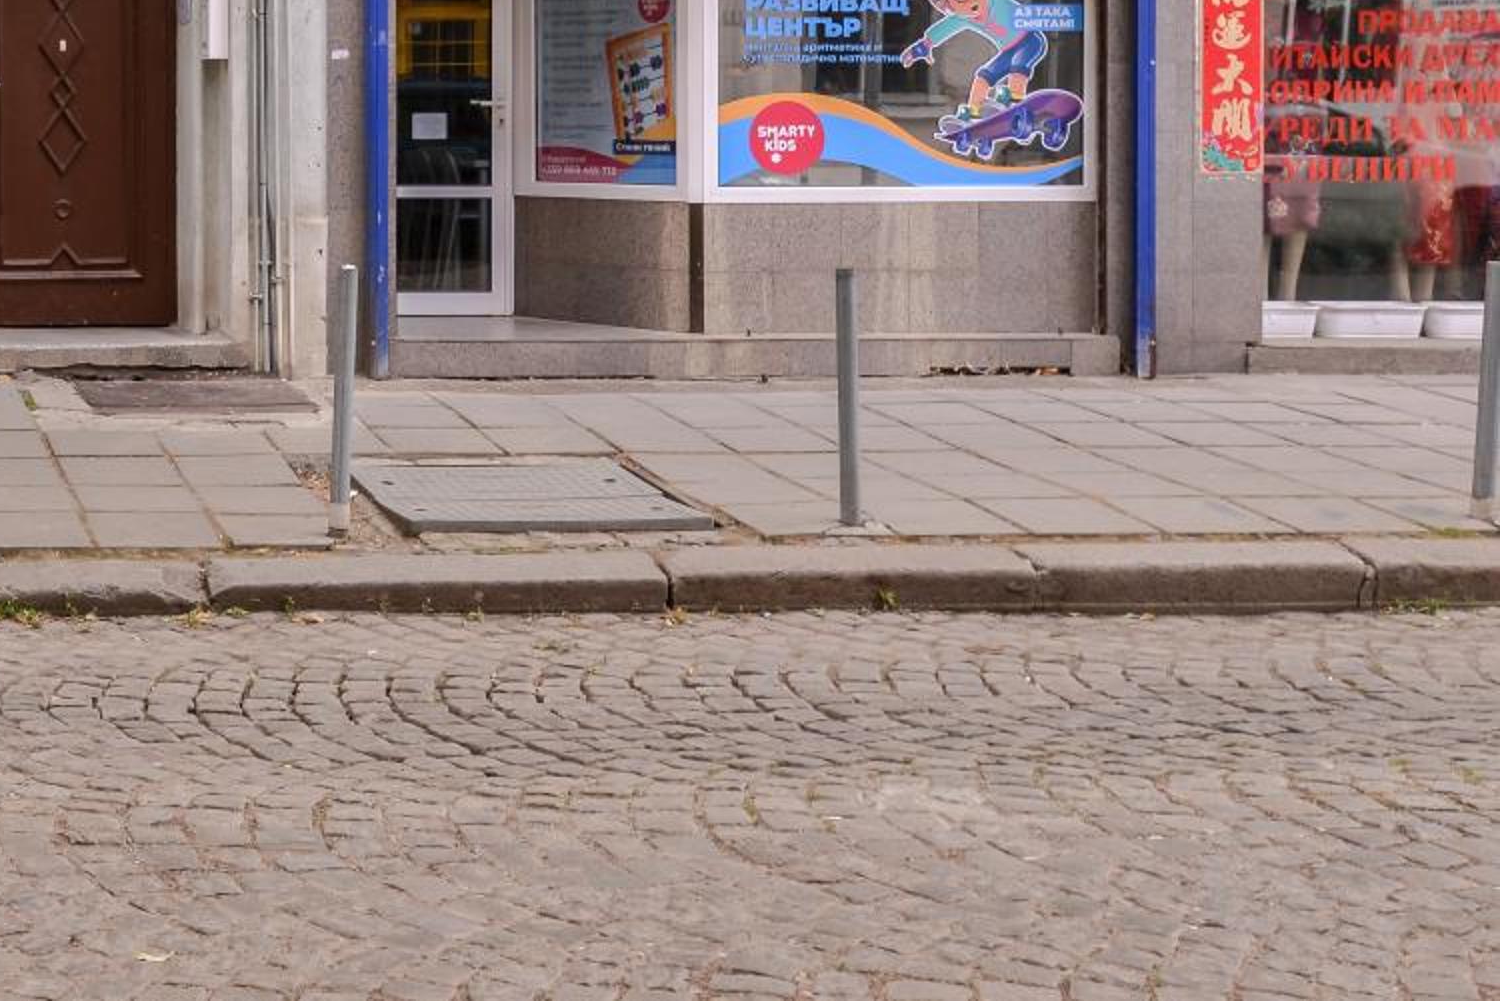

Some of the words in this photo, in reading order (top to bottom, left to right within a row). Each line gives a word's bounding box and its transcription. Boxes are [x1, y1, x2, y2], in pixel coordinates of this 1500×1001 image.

[1035, 6, 1072, 17] ТАКА
[745, 17, 862, 40] ЦЕНТЪР
[757, 124, 815, 139] SMARTY
[764, 137, 797, 152] KIDS
